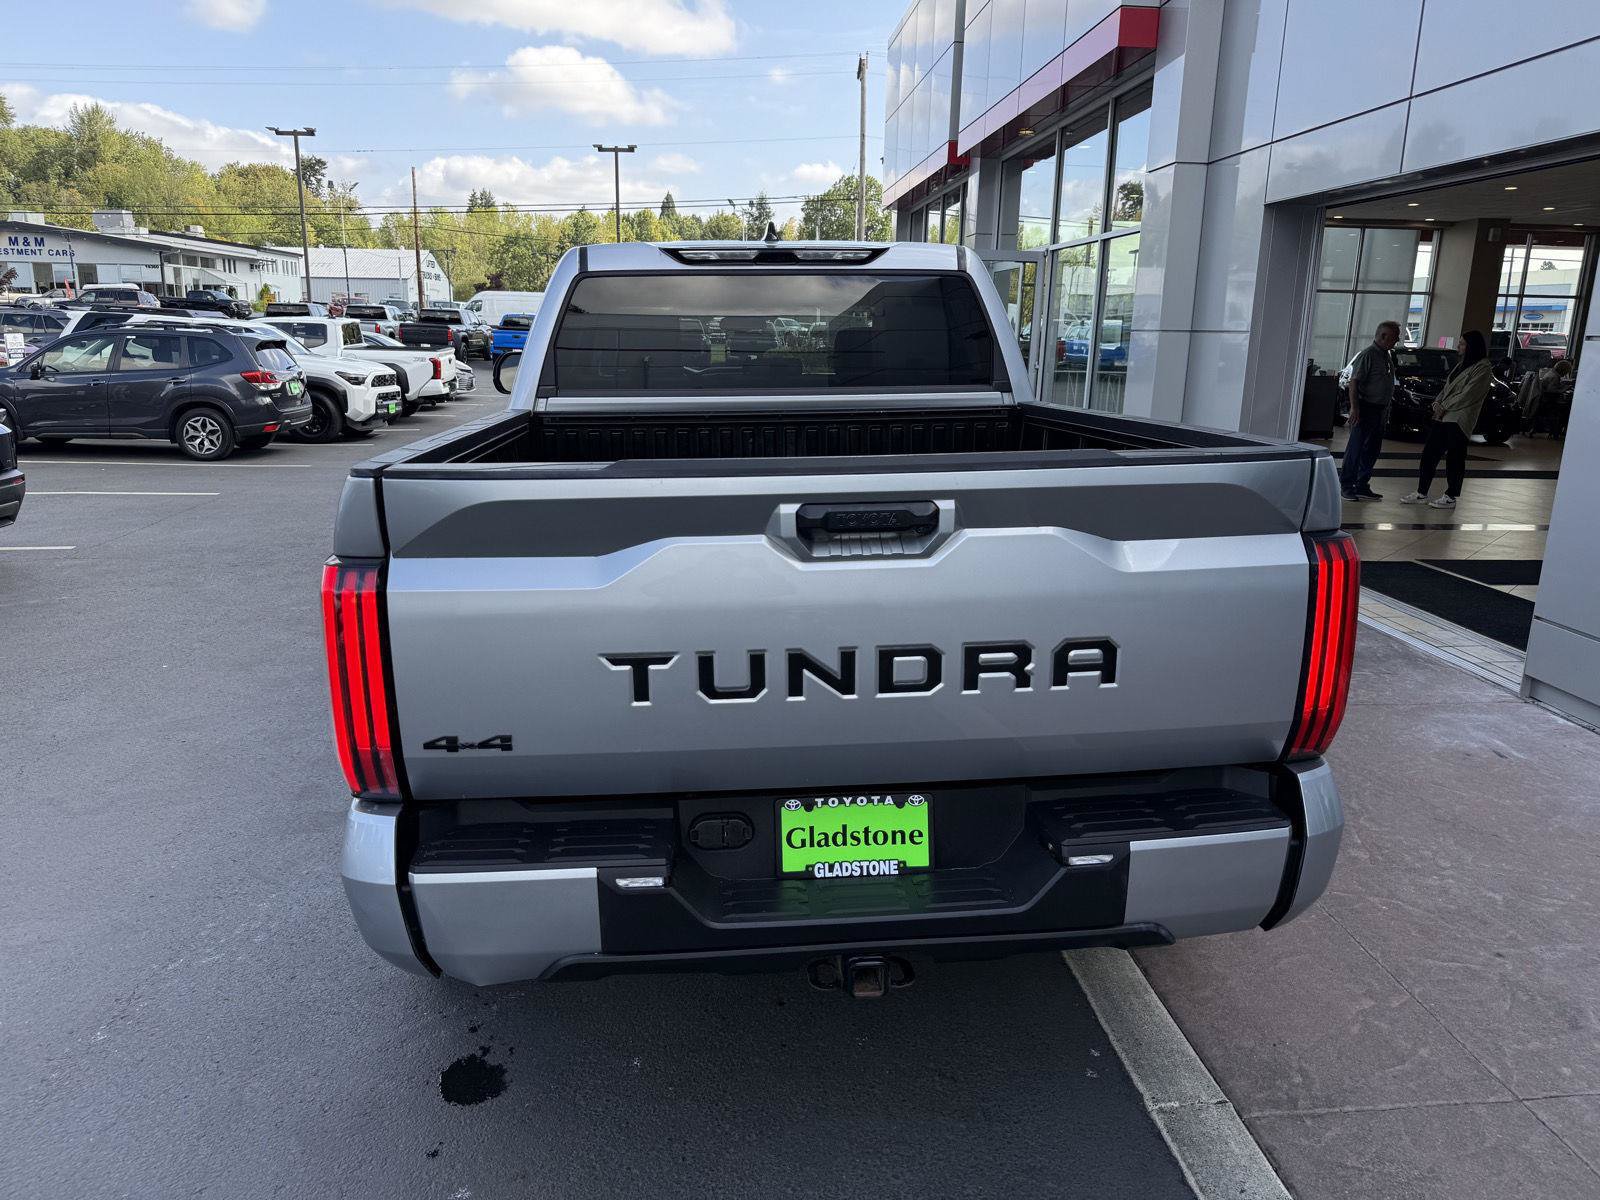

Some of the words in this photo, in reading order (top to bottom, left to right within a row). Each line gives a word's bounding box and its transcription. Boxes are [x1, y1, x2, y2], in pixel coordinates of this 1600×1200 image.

[8, 236, 19, 247] M
[22, 236, 31, 247] &
[34, 237, 45, 247] M
[47, 249, 76, 257] CARS
[836, 511, 897, 527] TOYOTA
[597, 636, 1122, 706] TUNDRA
[814, 795, 894, 808] TOYOTA
[785, 824, 924, 849] Gladstone
[814, 860, 899, 879] GLADSTONE
